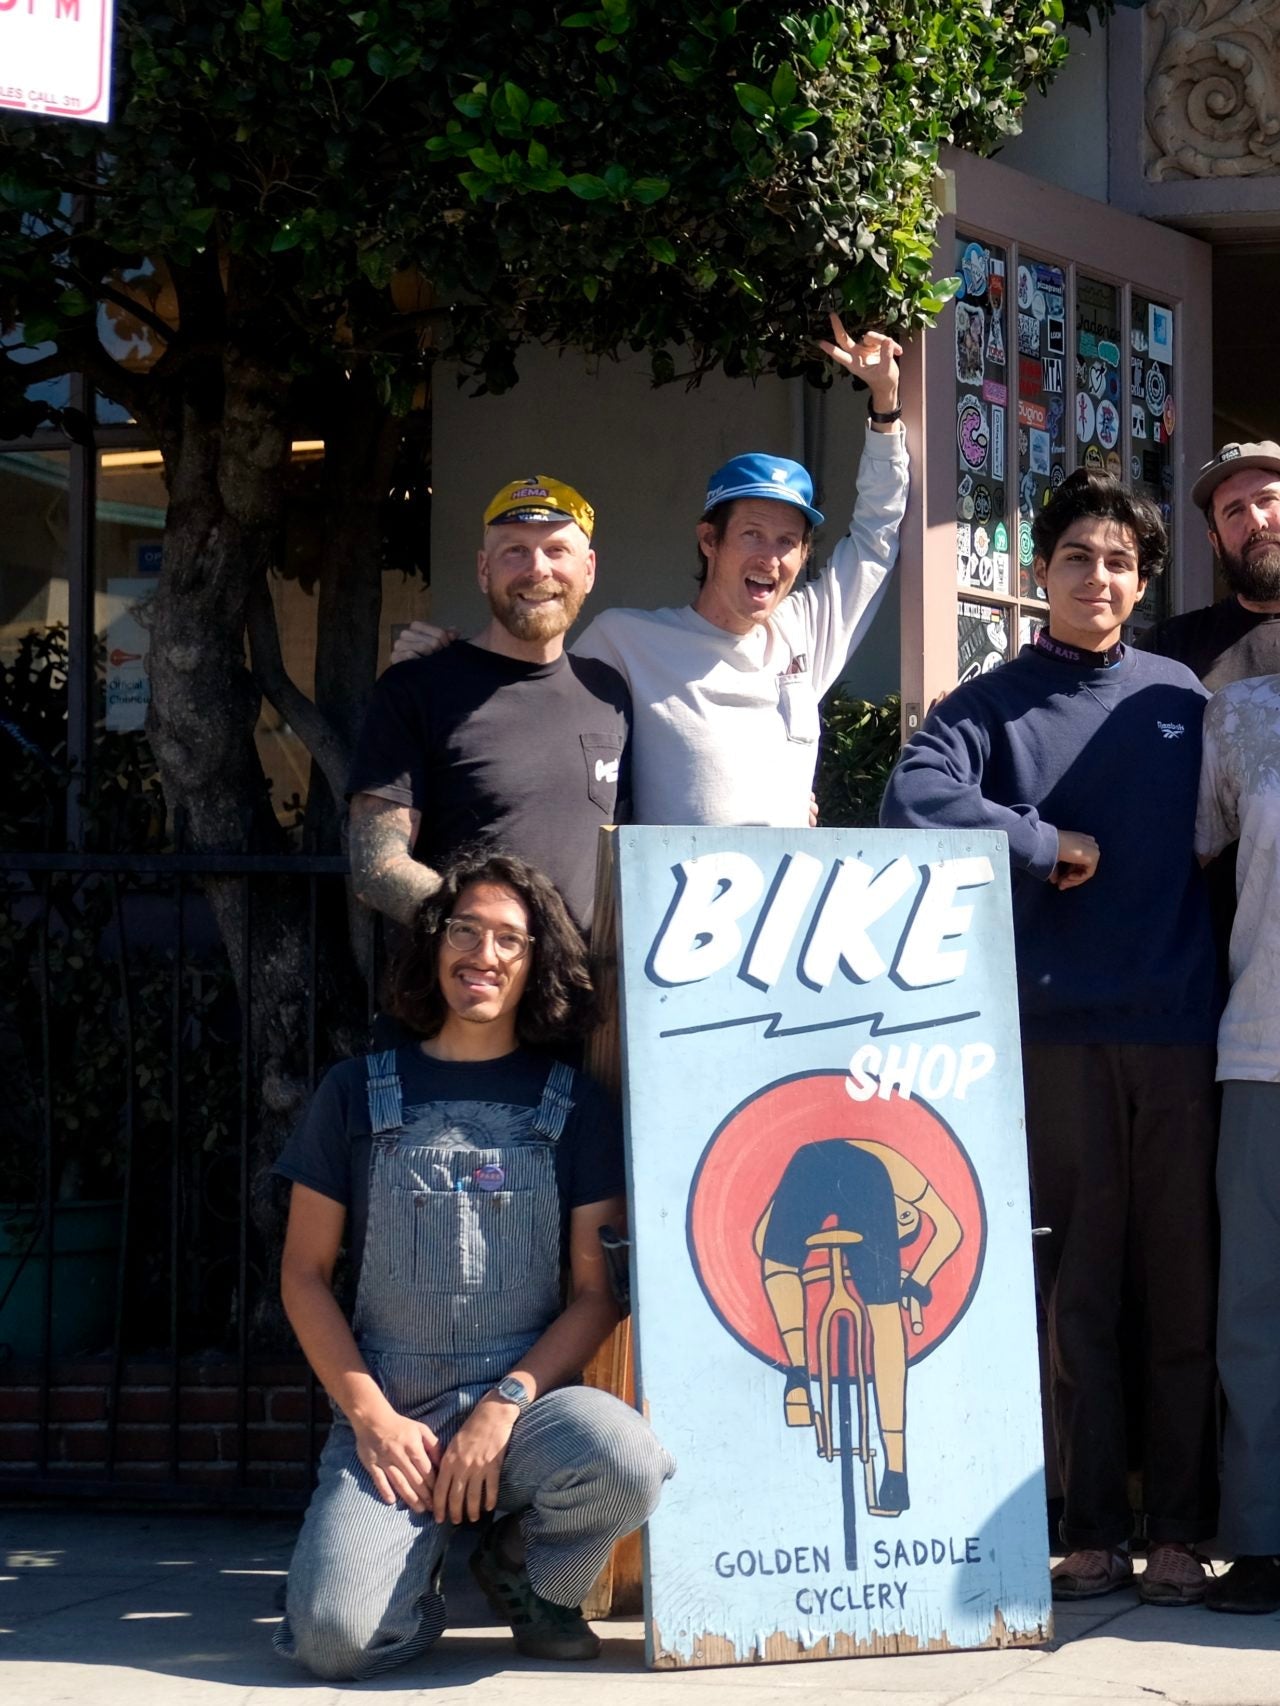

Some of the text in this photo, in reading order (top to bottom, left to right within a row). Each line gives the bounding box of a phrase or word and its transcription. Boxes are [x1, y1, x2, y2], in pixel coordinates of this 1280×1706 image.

[28, 90, 58, 104] CALL
[1018, 401, 1044, 425] Sugino
[512, 489, 548, 499] HEMA
[644, 850, 996, 994] BIKE
[845, 1042, 996, 1102] SHOP
[715, 1537, 982, 1578] GOLDEN SADDLE
[796, 1581, 908, 1615] CYCLERY
